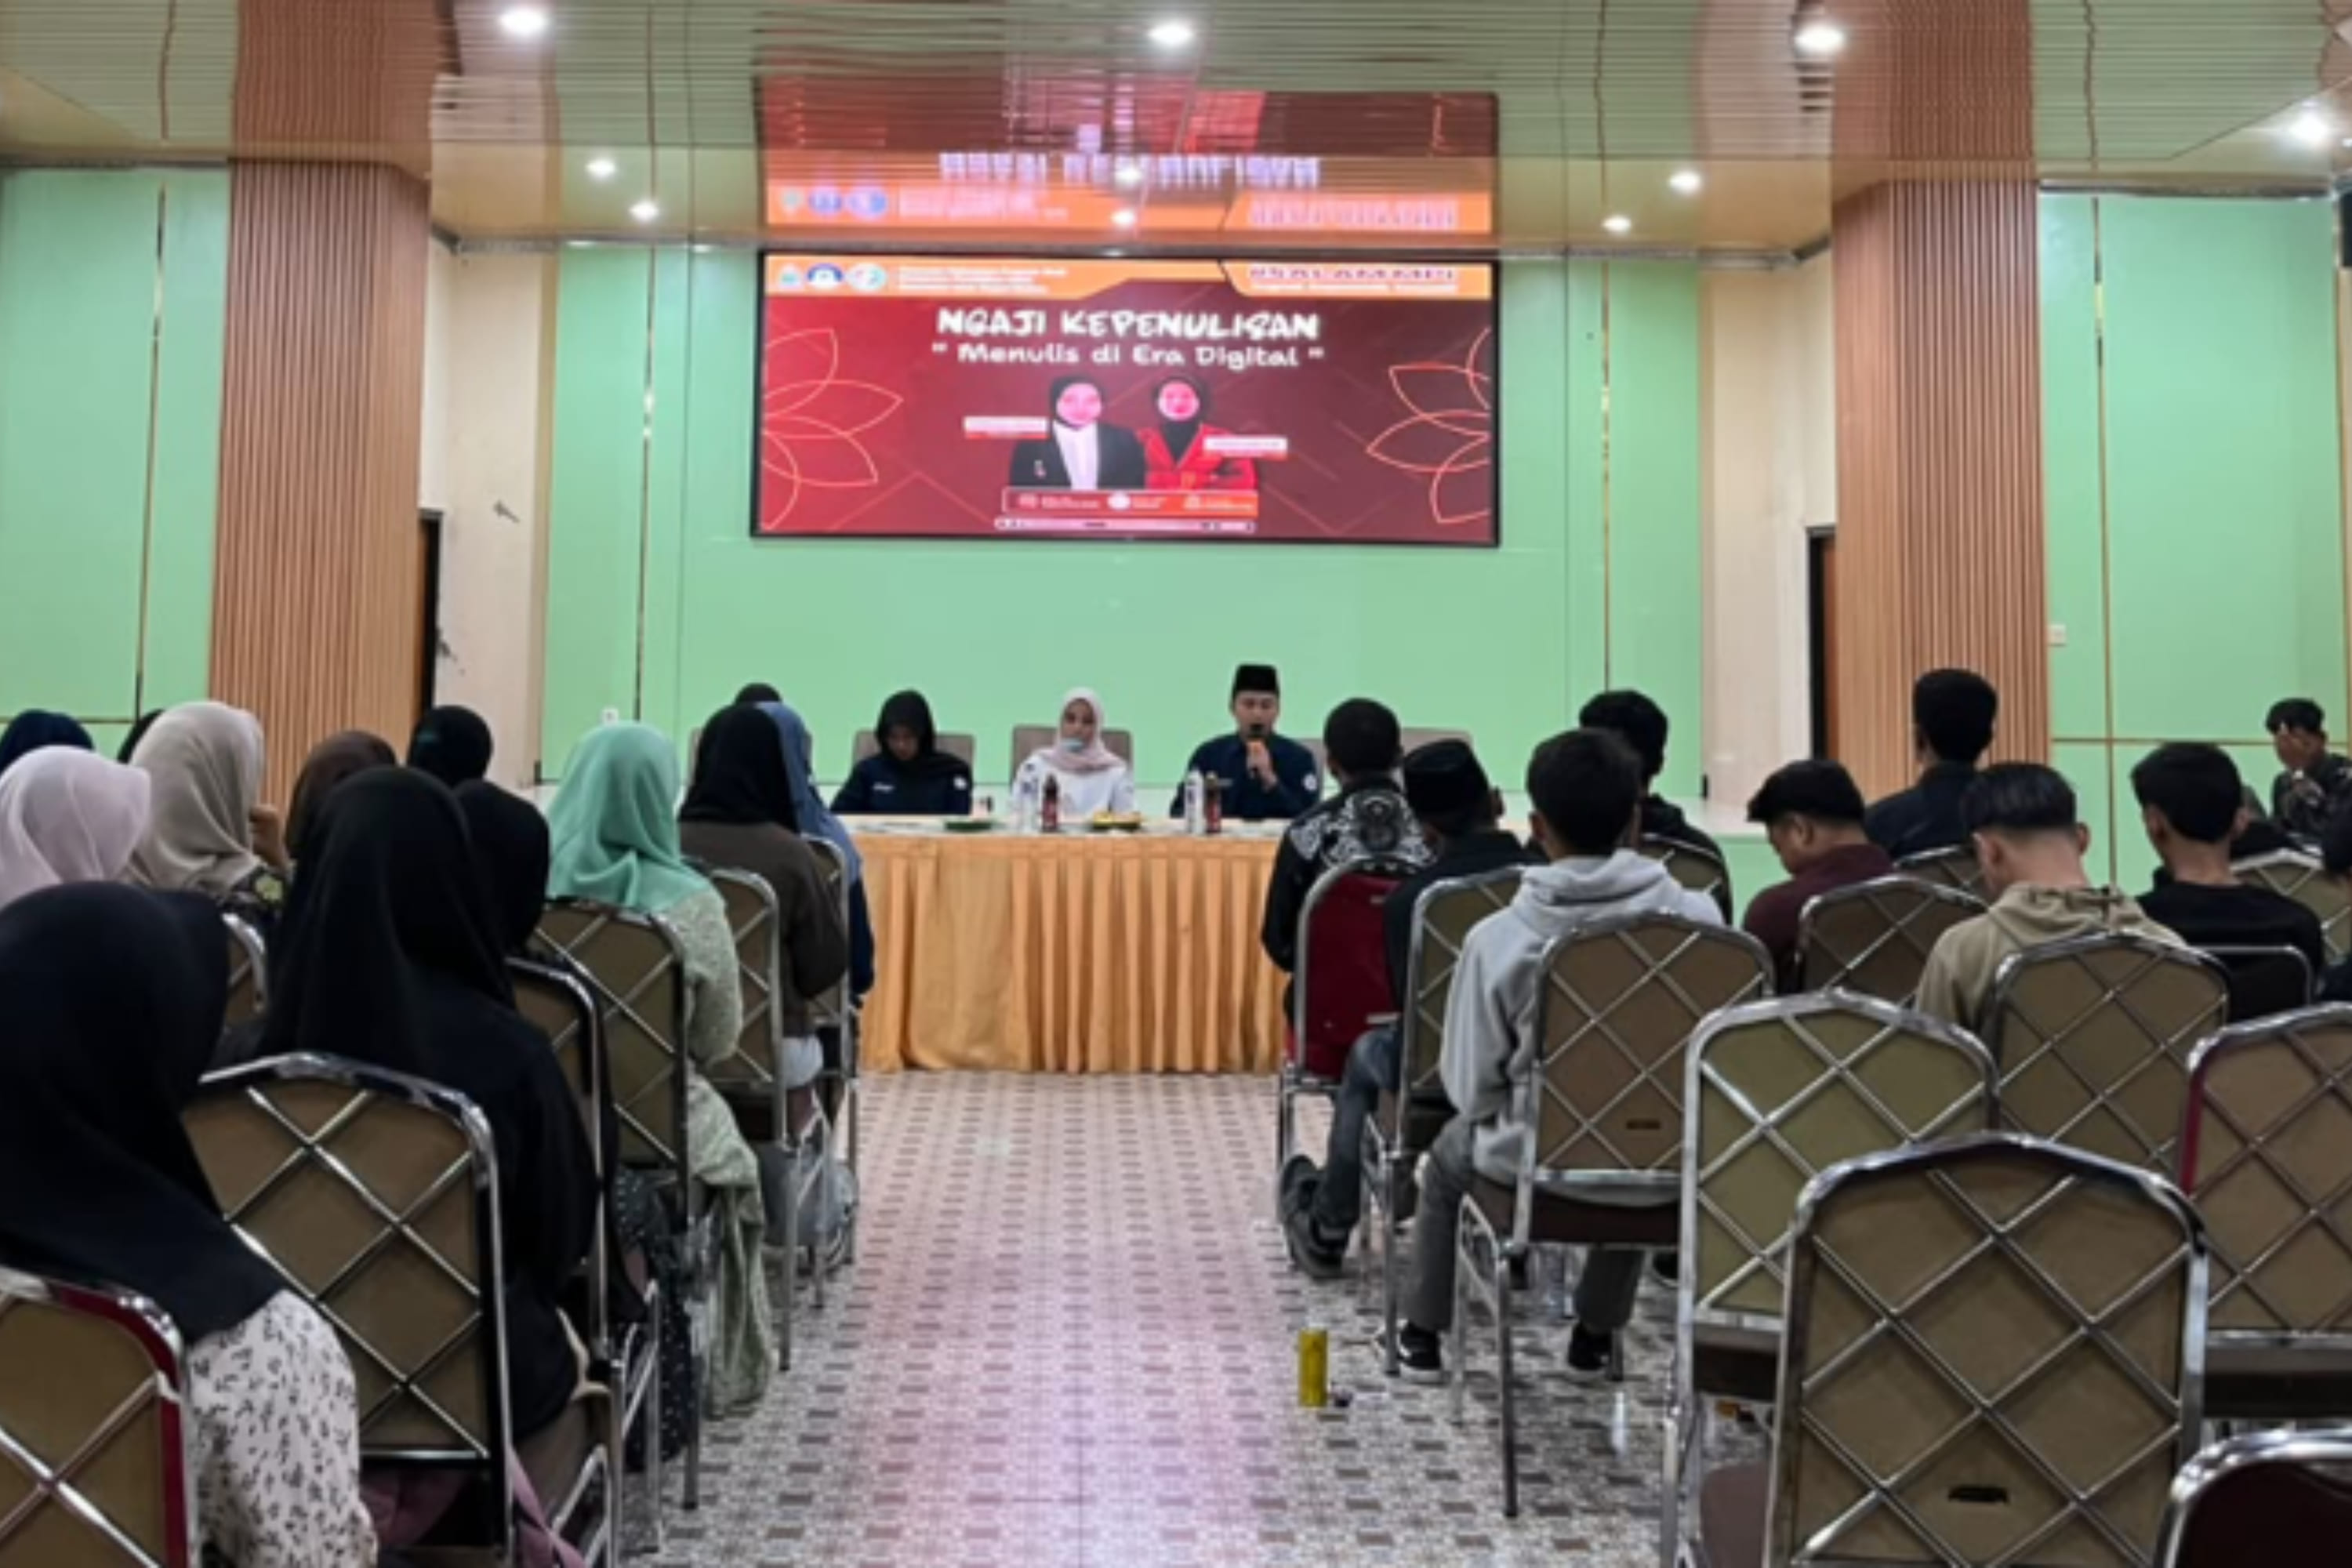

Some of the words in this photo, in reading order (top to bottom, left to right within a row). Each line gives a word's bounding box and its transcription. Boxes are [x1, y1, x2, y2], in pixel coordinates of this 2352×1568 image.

[937, 307, 1047, 336] NGAJI
[1060, 308, 1319, 340] KEPENULISAN
[957, 342, 1080, 364] Menulis
[1091, 343, 1122, 365] di
[1131, 343, 1186, 366] Era
[1195, 345, 1298, 372] Digital
